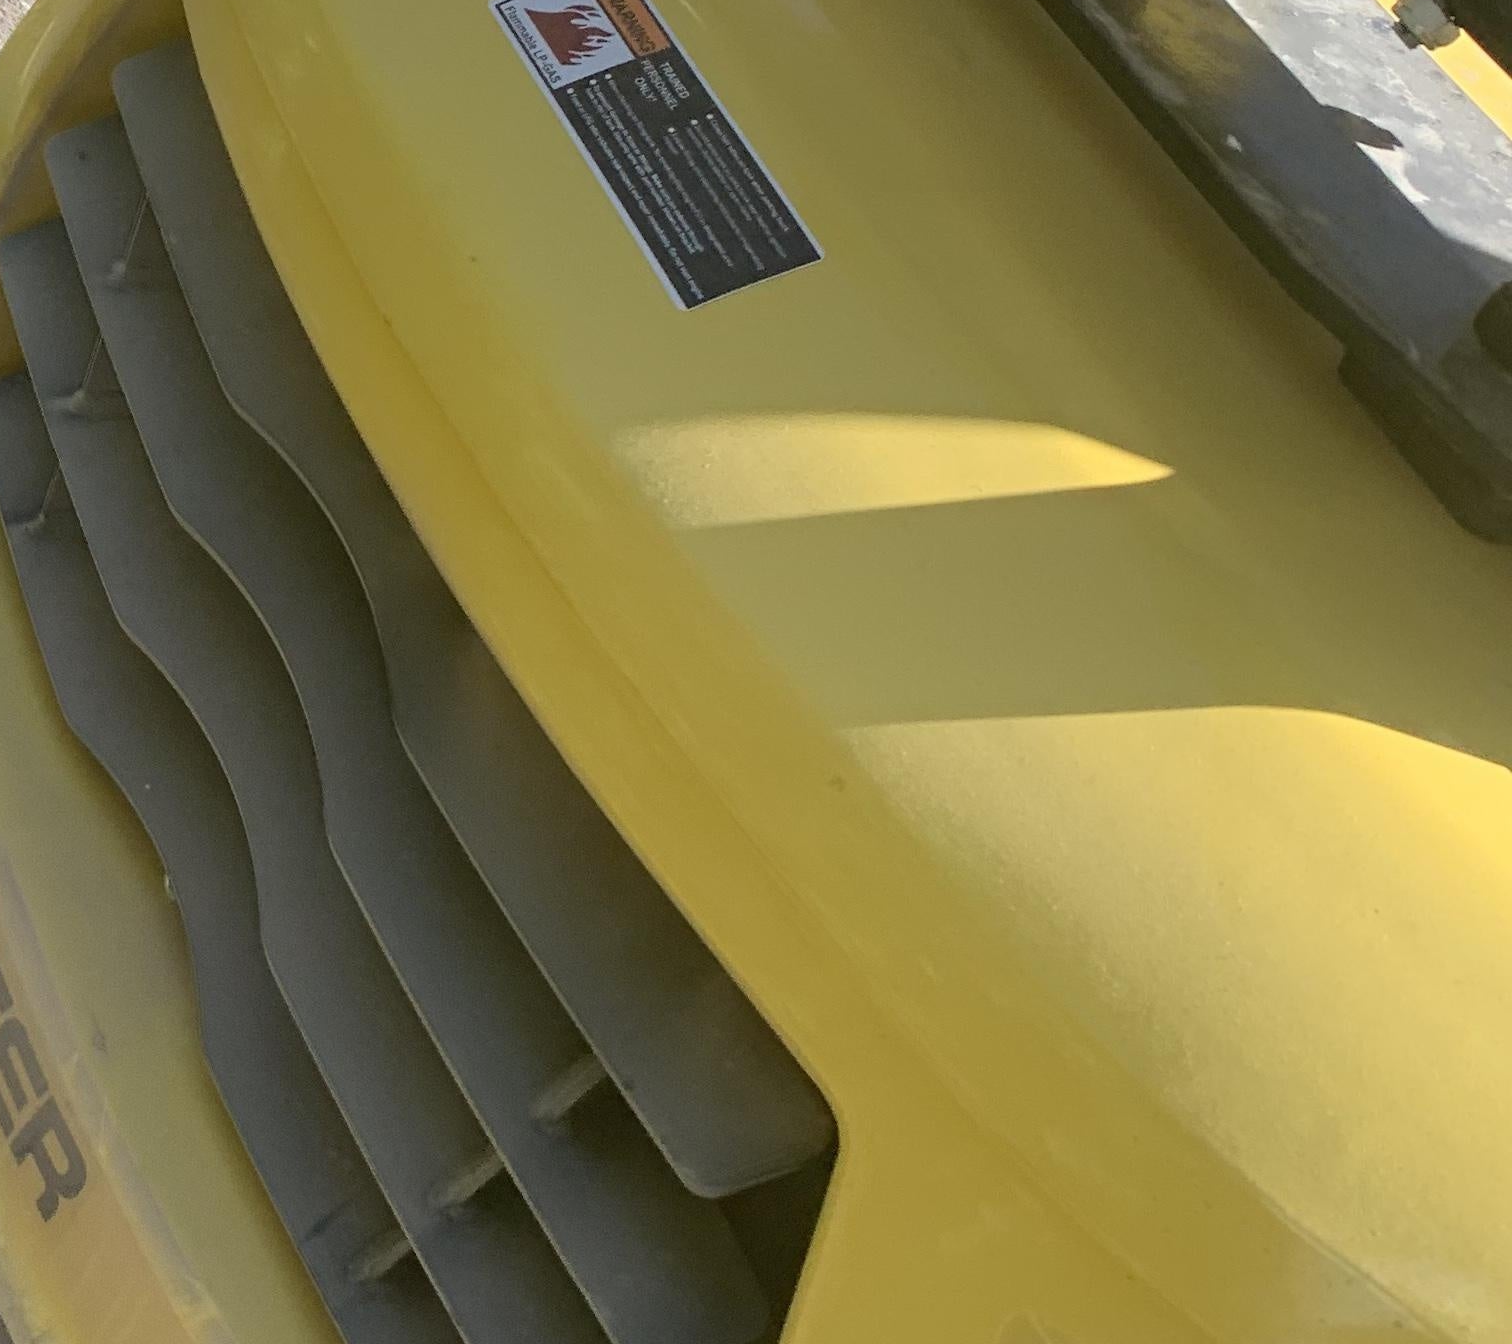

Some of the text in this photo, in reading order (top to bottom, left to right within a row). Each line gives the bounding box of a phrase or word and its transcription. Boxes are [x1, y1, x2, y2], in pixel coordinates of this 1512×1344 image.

[505, 6, 563, 85] Flammable LP-GAS
[640, 58, 679, 111] PERSONNEL
[659, 61, 690, 99] TRAINED
